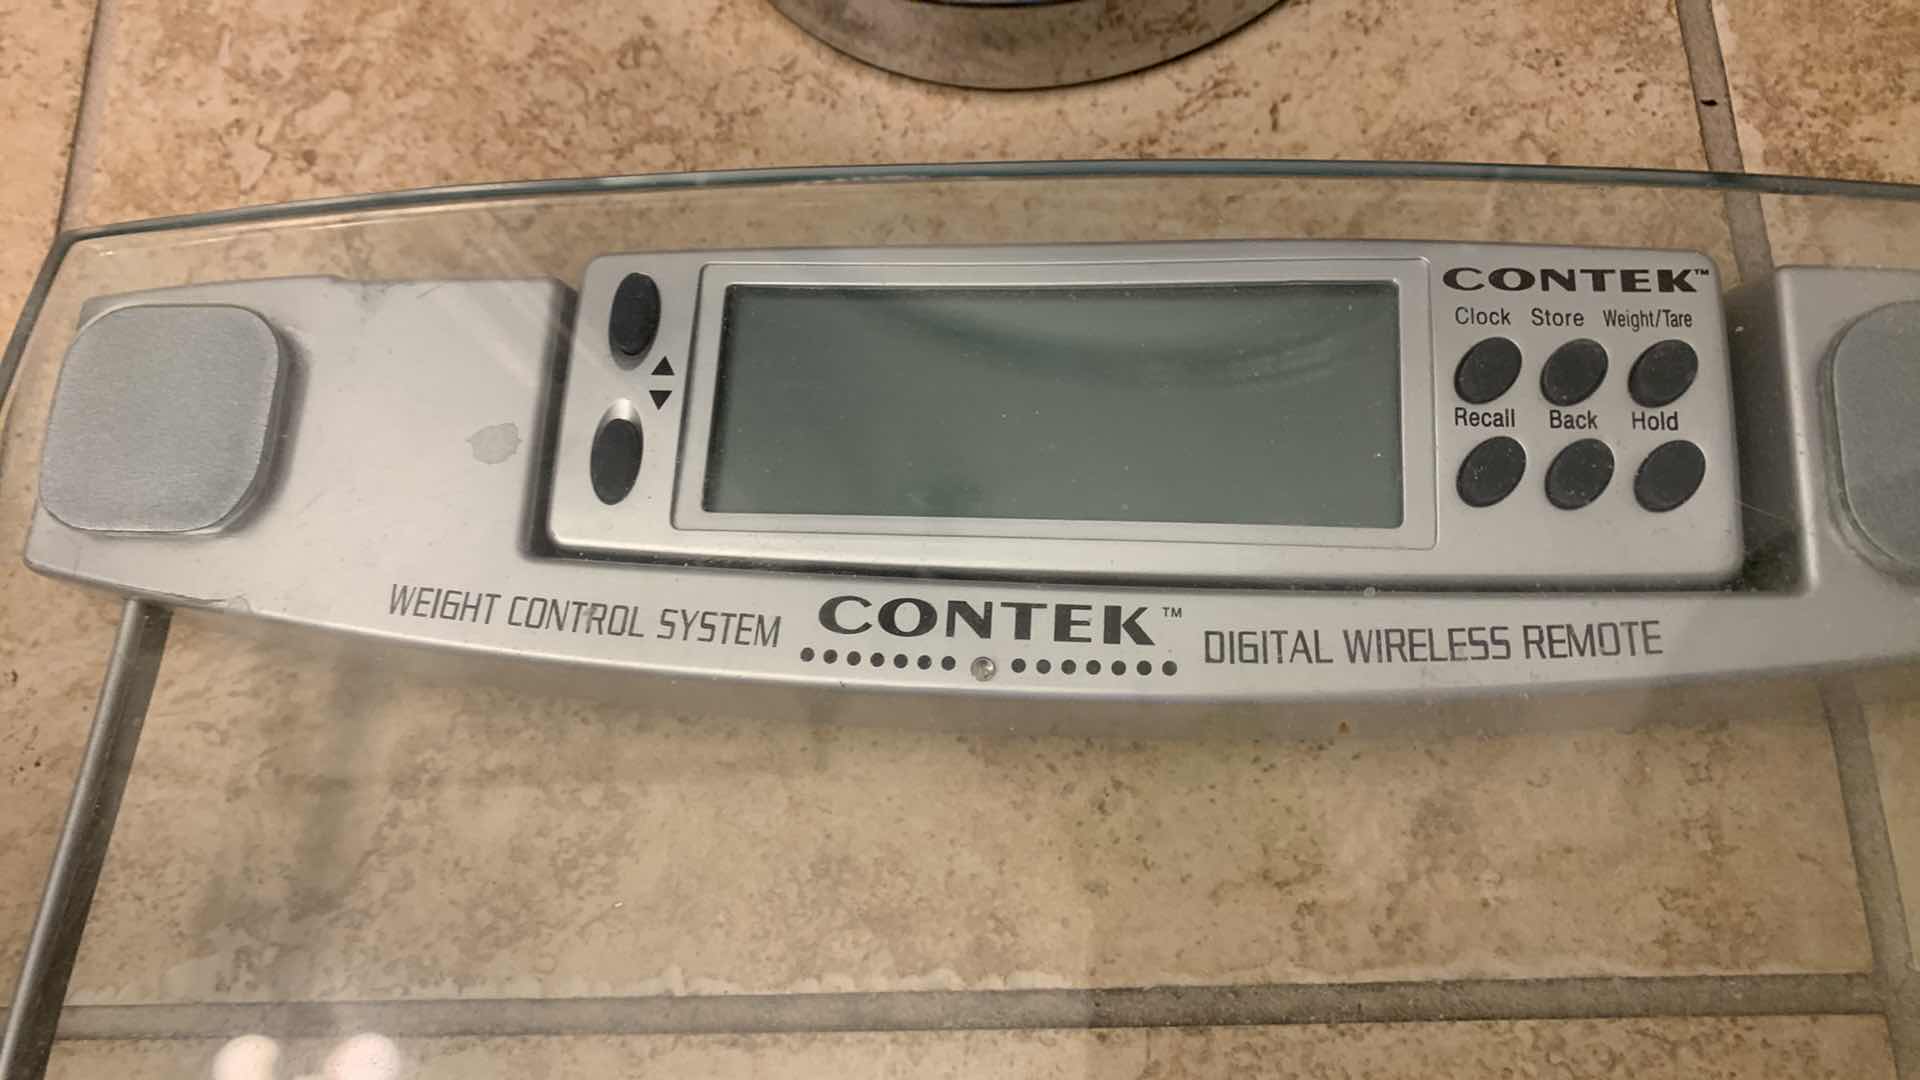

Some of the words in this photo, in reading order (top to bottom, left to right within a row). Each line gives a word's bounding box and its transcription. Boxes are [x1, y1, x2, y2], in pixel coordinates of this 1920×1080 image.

[1442, 267, 1697, 293] CONTEK
[1454, 306, 1512, 326] Clock
[1530, 307, 1585, 327] Store
[1602, 308, 1693, 332] Weight/Tare
[1454, 407, 1516, 428] Recall
[1549, 409, 1599, 430] Back
[1631, 411, 1679, 431] Hold
[388, 583, 502, 625] WEIGHT
[507, 595, 645, 639] CONTROL
[656, 608, 782, 648] SYSTEM
[818, 595, 1156, 646] CONTEK
[1203, 629, 1334, 665] DIGITAL
[1342, 625, 1512, 664] WIRELESS
[1521, 619, 1664, 661] REMOTE
